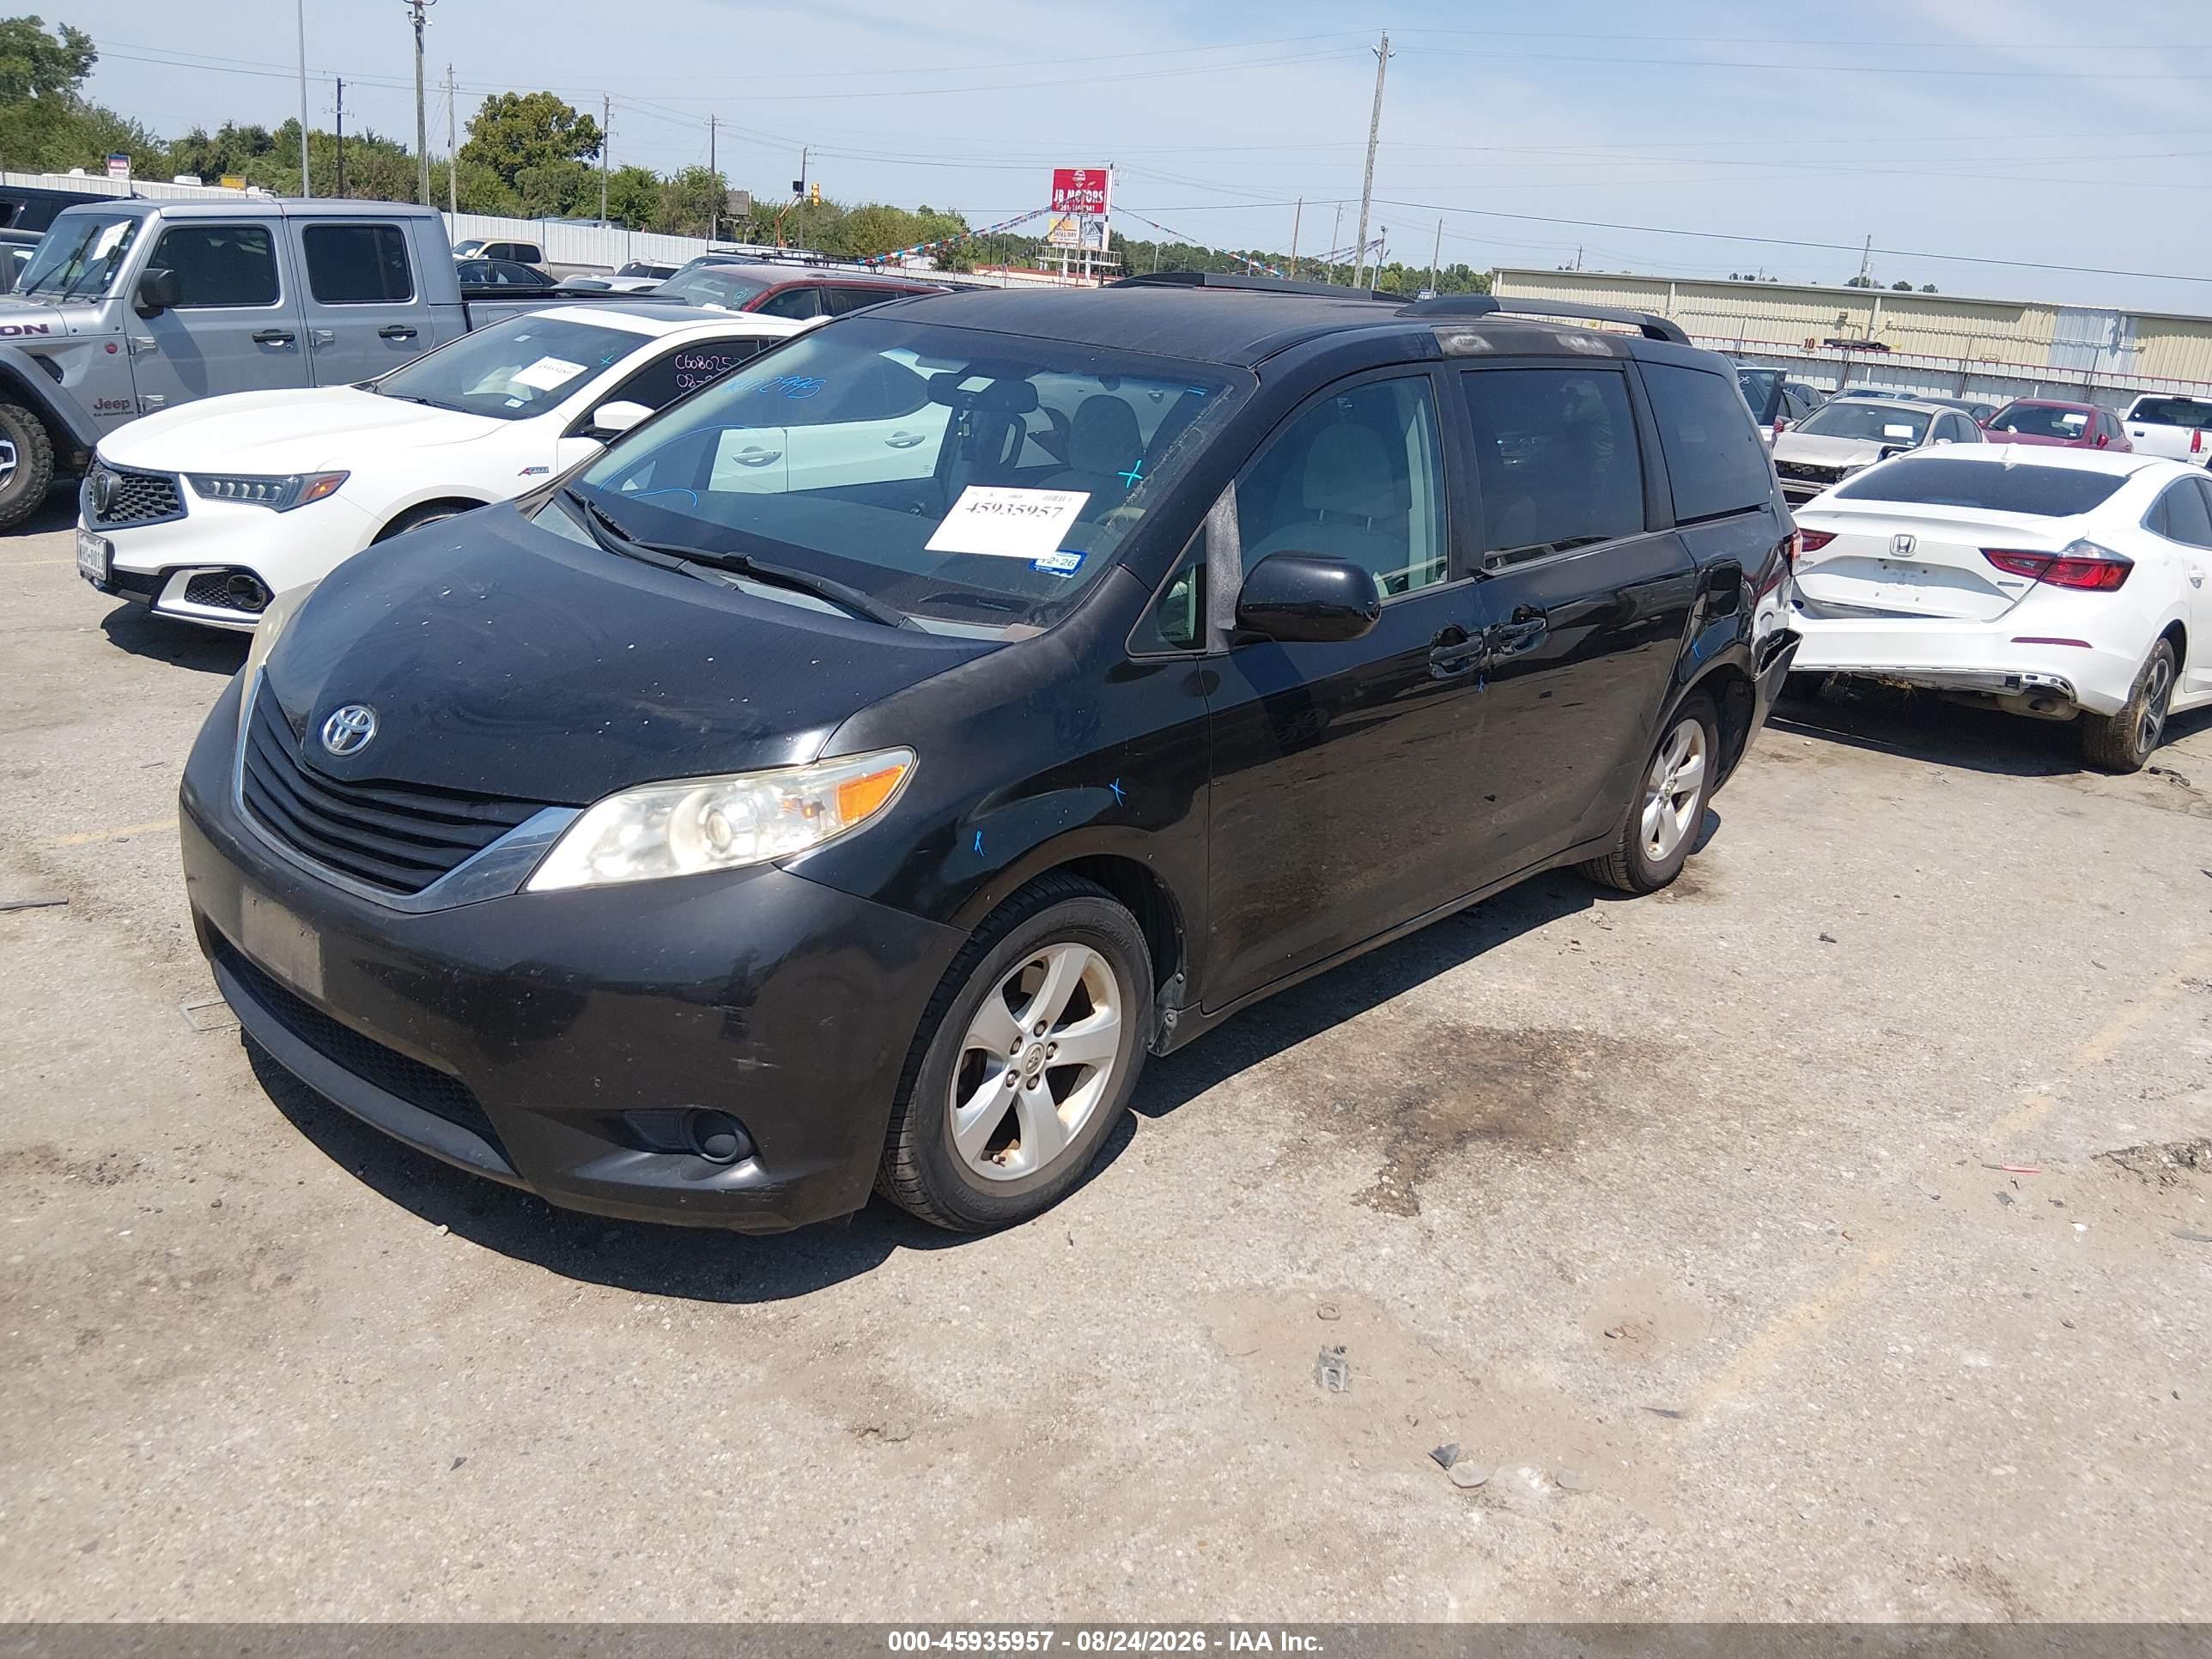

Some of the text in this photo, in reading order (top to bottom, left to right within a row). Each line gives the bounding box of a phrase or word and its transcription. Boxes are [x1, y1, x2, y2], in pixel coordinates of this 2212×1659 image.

[1054, 189, 1064, 204] JB
[0, 324, 49, 336] ON
[1804, 338, 1814, 349] 10
[94, 398, 131, 410] Jeep
[966, 501, 1065, 519] 45935957
[1060, 558, 1077, 567] 26
